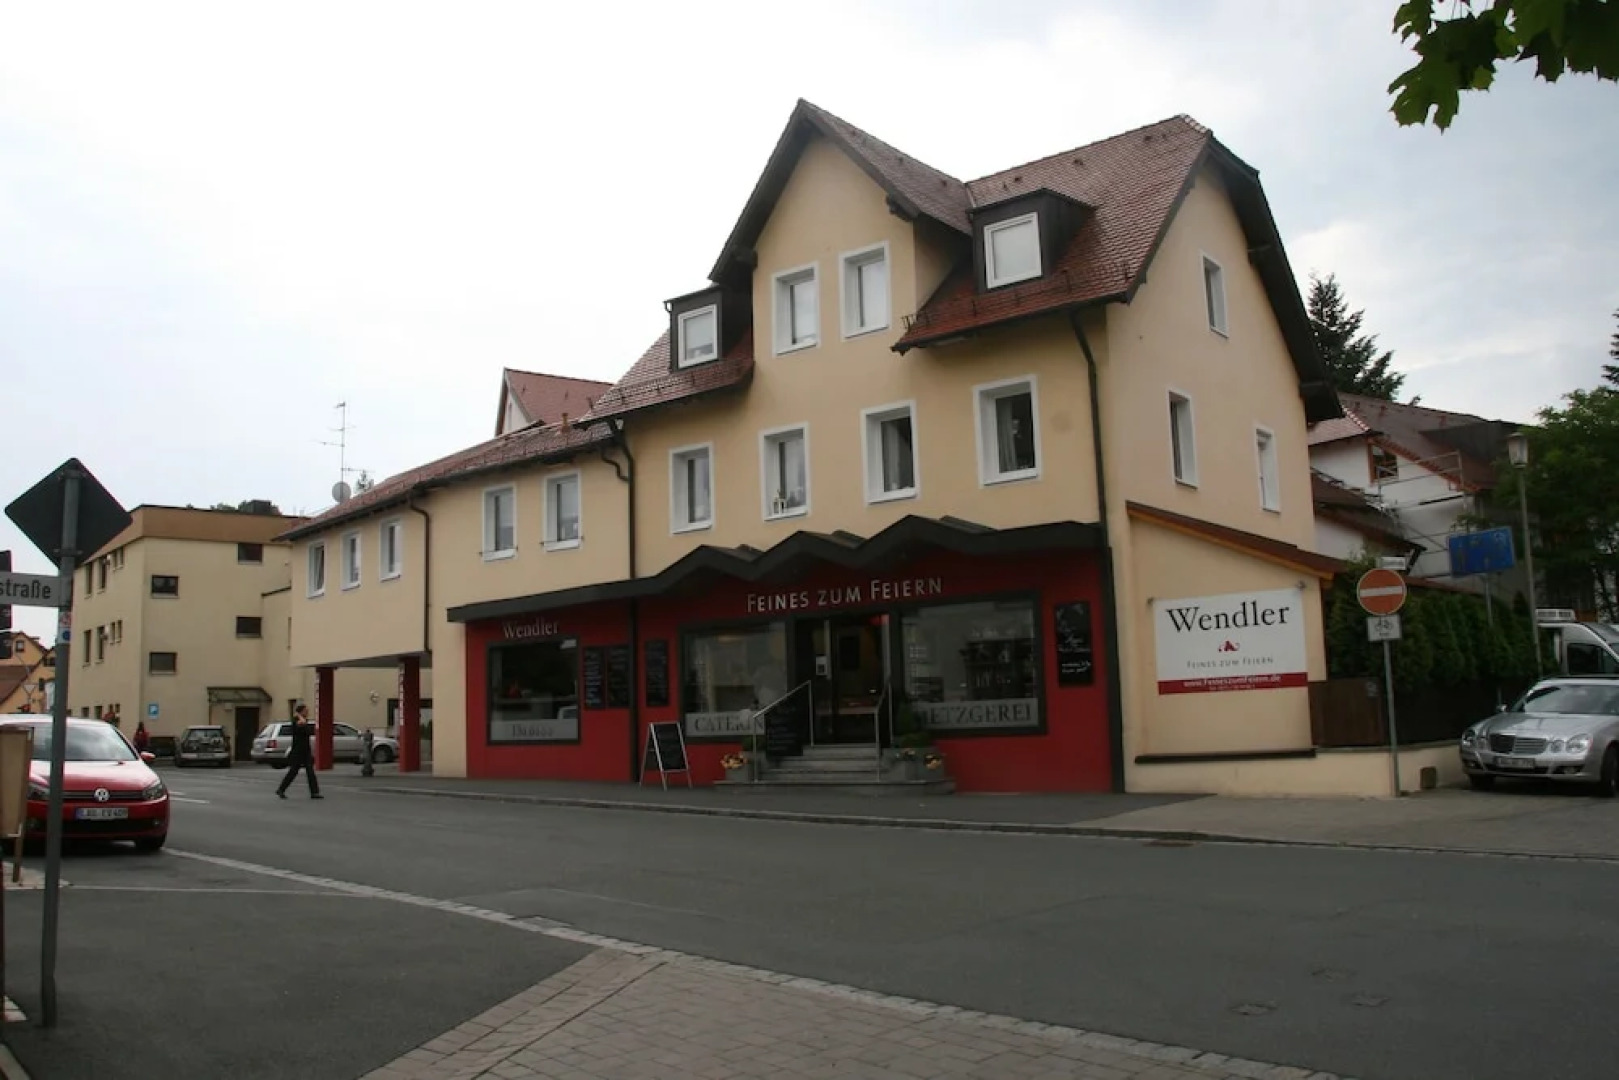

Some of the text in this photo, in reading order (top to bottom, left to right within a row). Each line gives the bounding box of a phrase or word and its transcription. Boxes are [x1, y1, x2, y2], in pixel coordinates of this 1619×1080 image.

[748, 577, 943, 613] FEINES ZUM FEIERN
[502, 617, 560, 639] Wendler
[1165, 599, 1290, 633] Wendler
